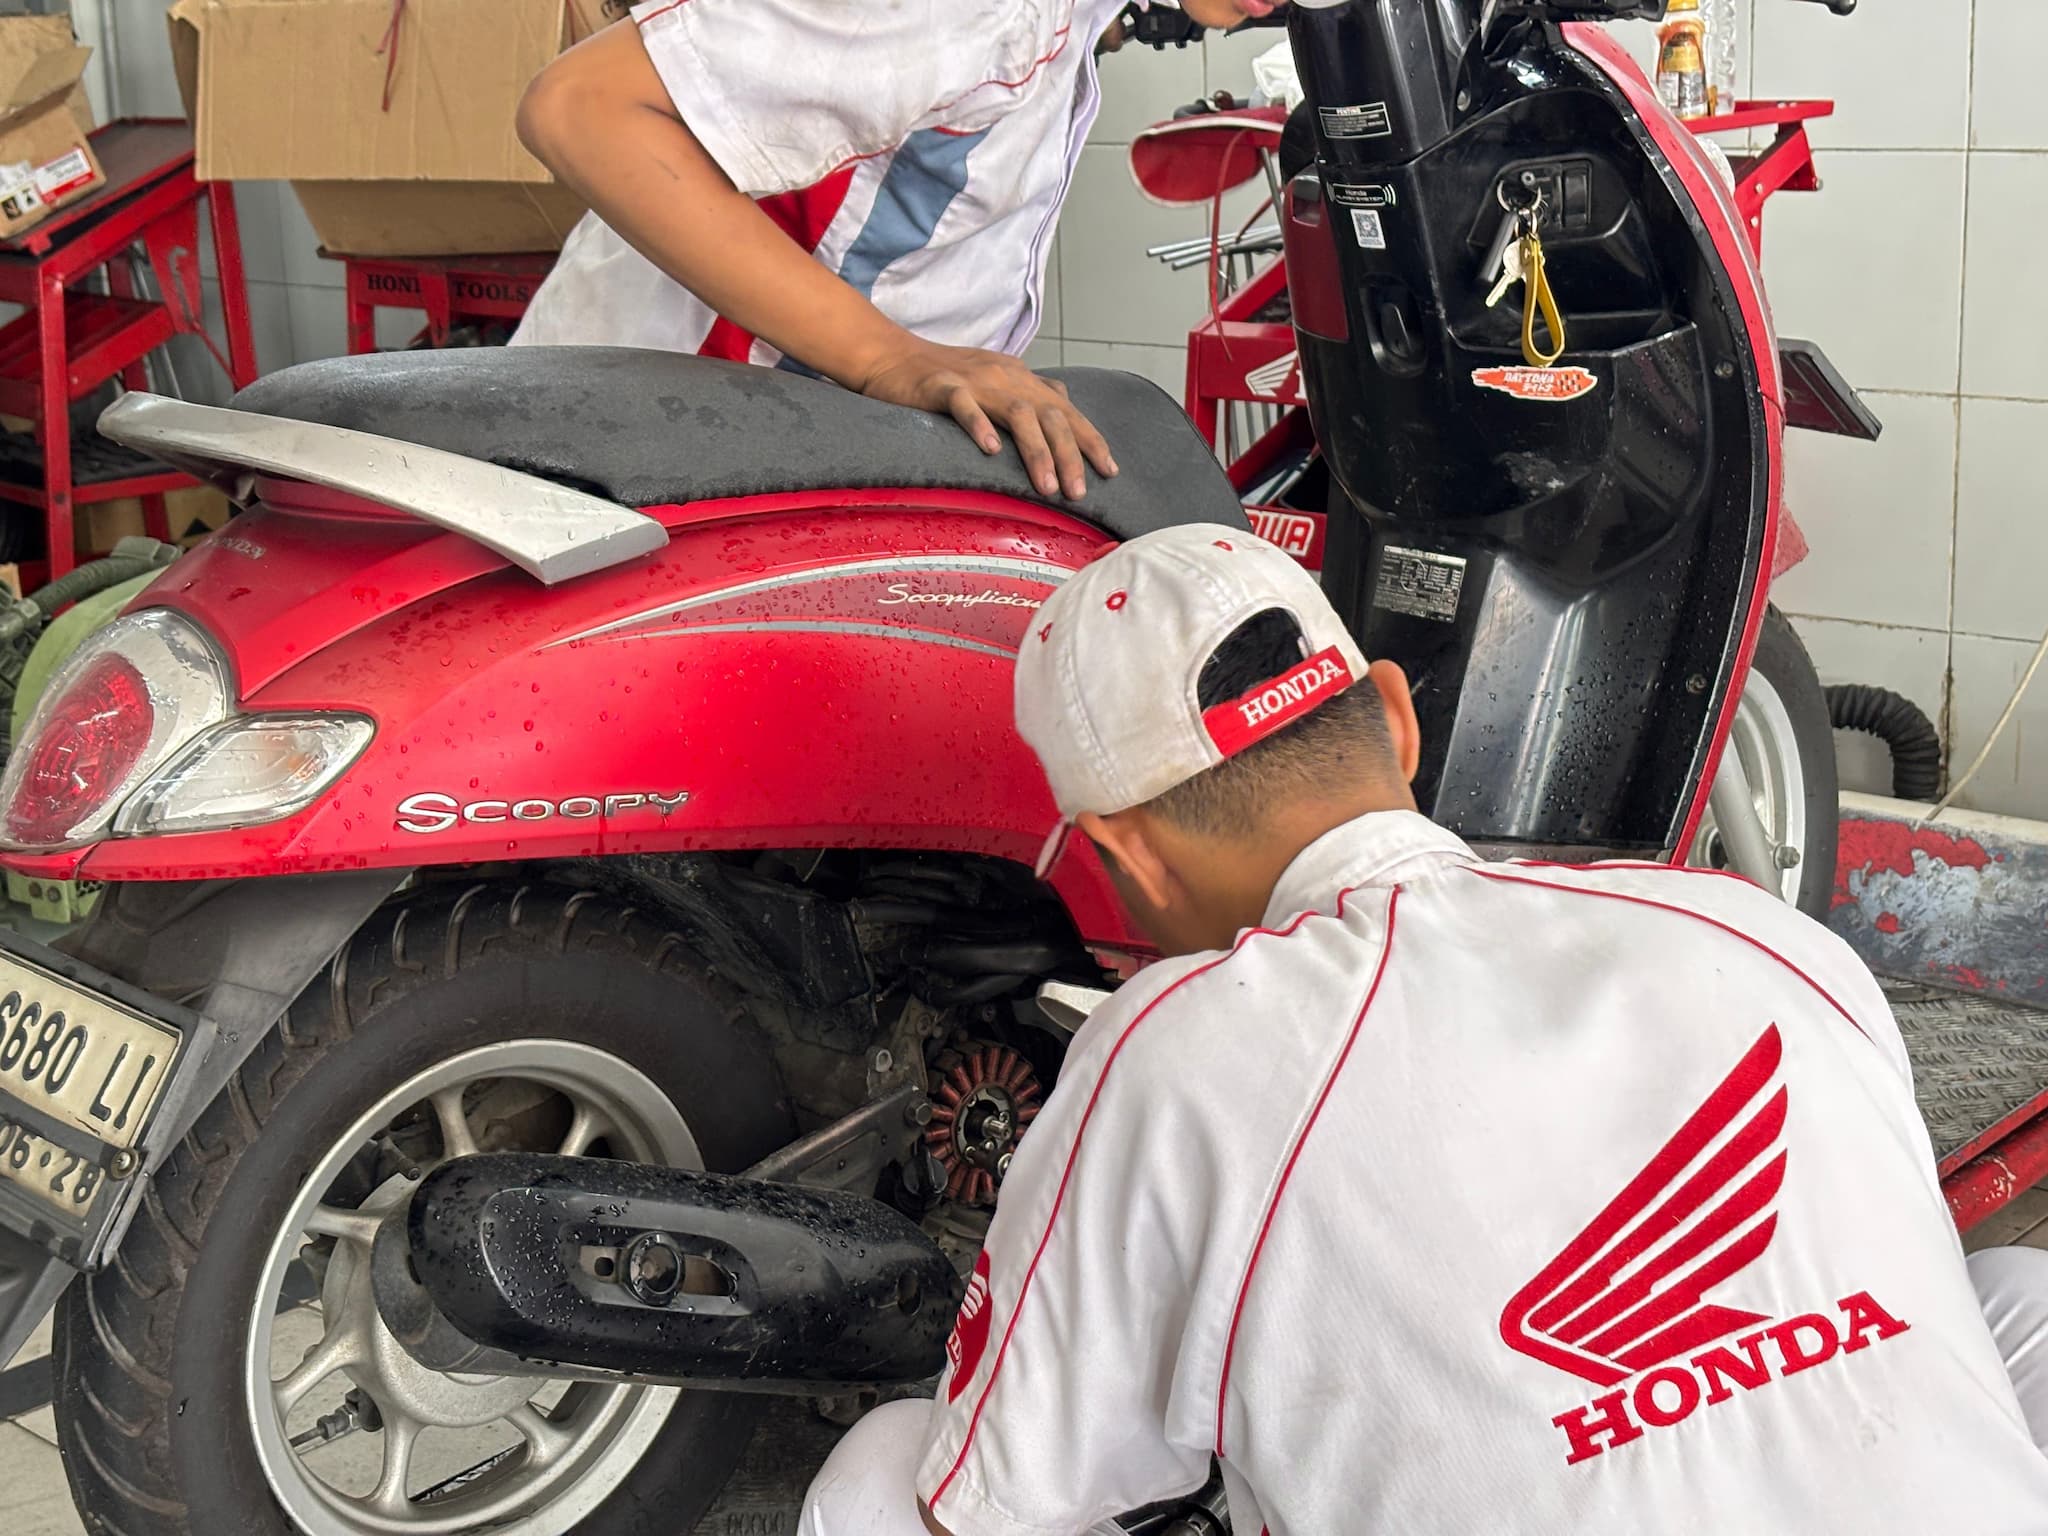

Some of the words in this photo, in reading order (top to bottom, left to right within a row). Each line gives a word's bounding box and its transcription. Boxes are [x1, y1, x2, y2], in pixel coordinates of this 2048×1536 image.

[454, 281, 529, 302] TOOLS
[877, 583, 1041, 608] Scoopyliciou
[1239, 658, 1345, 727] HONDA
[397, 792, 688, 833] SCOOPY
[89, 1043, 156, 1130] LI
[1551, 1290, 1911, 1466] HONDA
